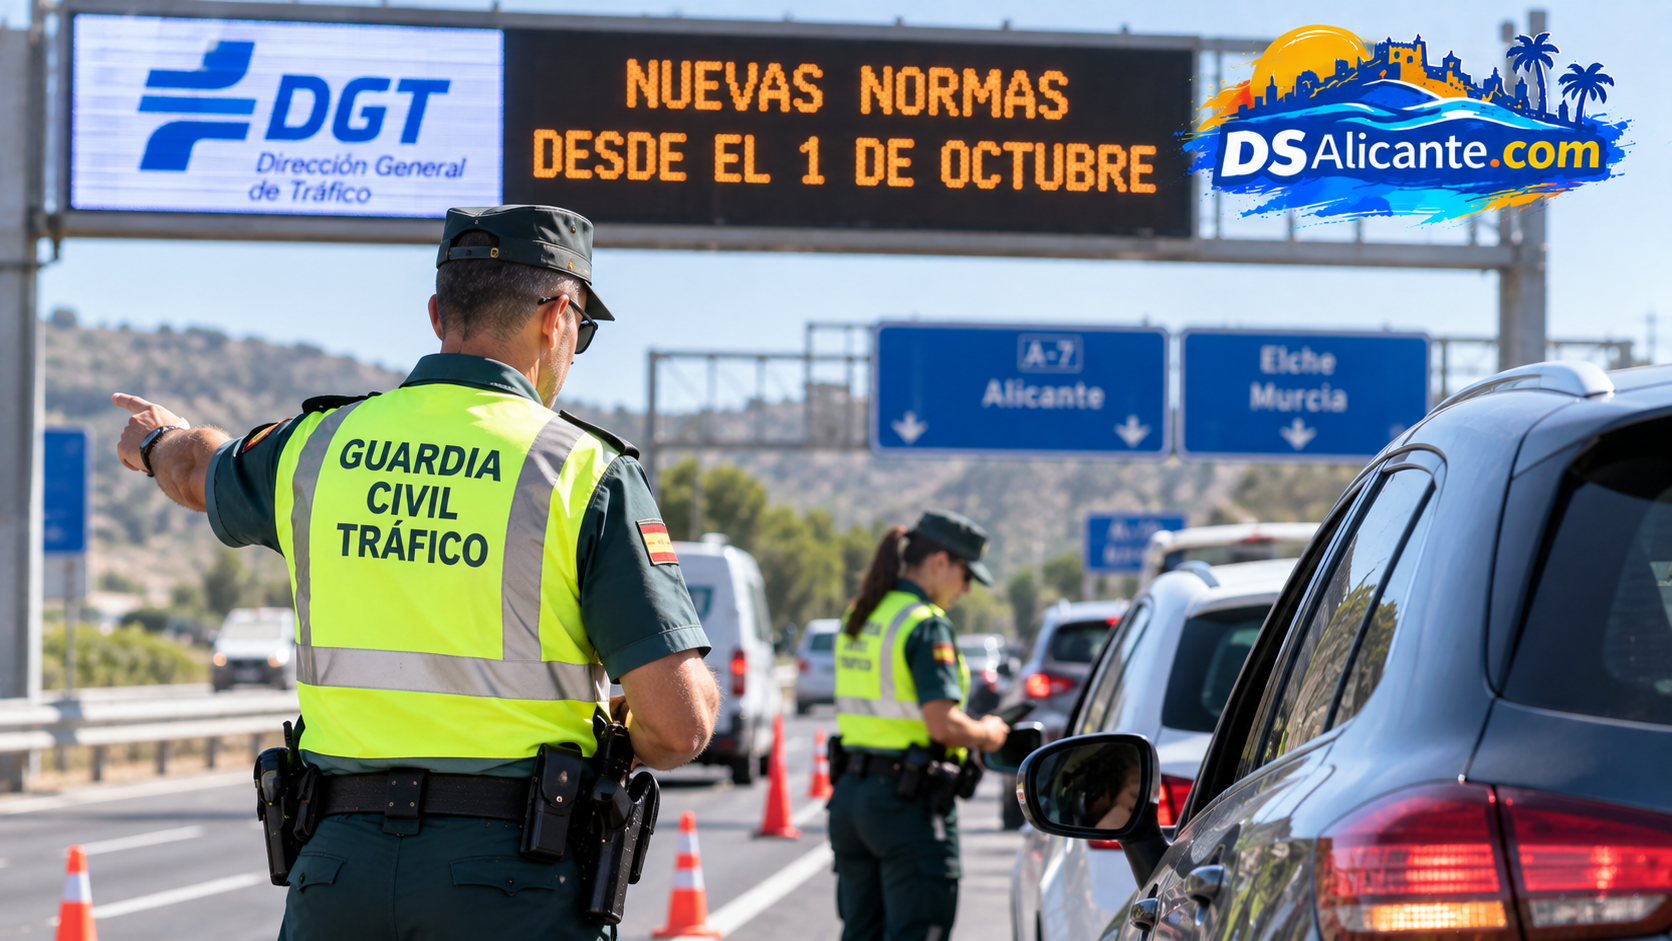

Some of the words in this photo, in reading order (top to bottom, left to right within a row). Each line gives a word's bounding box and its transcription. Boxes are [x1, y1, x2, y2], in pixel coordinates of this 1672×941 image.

[627, 58, 823, 114] NUEVAS
[861, 65, 1068, 120] NORMAS
[265, 74, 451, 144] DGT
[256, 152, 367, 175] Dirección
[375, 155, 466, 179] General
[533, 128, 687, 181] DESDE
[714, 134, 771, 184] EL
[800, 136, 825, 184] 1
[856, 137, 914, 187] DE
[941, 140, 1156, 193] OCTUBRE
[249, 181, 280, 202] de
[291, 180, 371, 204] Tráfico
[1024, 340, 1075, 364] A-7
[1260, 345, 1336, 375] Elche
[982, 380, 1105, 409] Alicante
[1250, 383, 1348, 412] Murcia
[339, 439, 501, 482] GUARDIA
[366, 482, 458, 519] CIVIL
[337, 519, 488, 567] TRÁFICO
